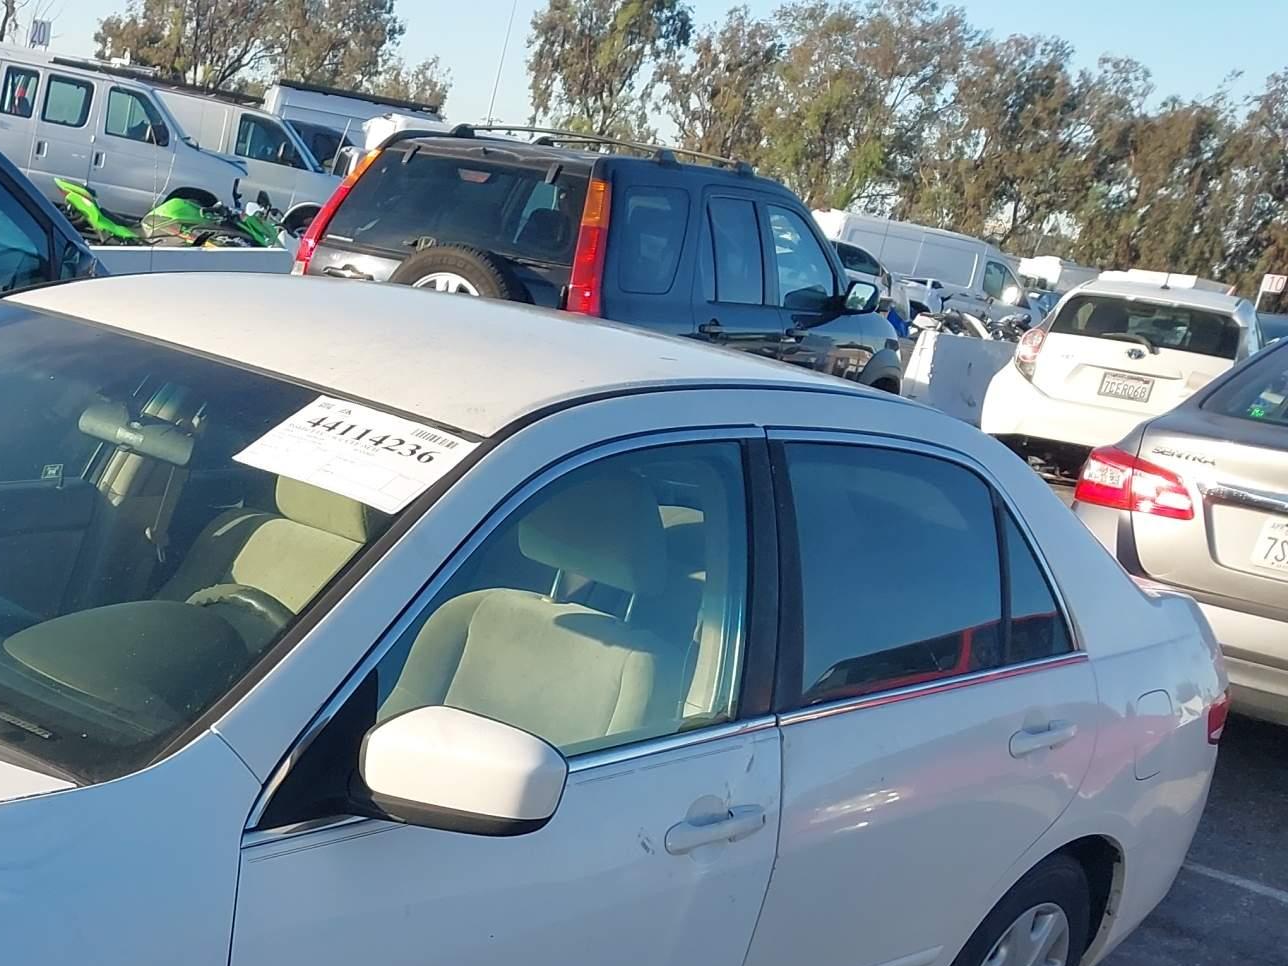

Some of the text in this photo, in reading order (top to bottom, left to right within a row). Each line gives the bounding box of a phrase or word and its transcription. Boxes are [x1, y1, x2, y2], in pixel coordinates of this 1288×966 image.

[31, 20, 46, 45] 20
[1269, 276, 1285, 292] 10
[306, 416, 441, 464] 44114236
